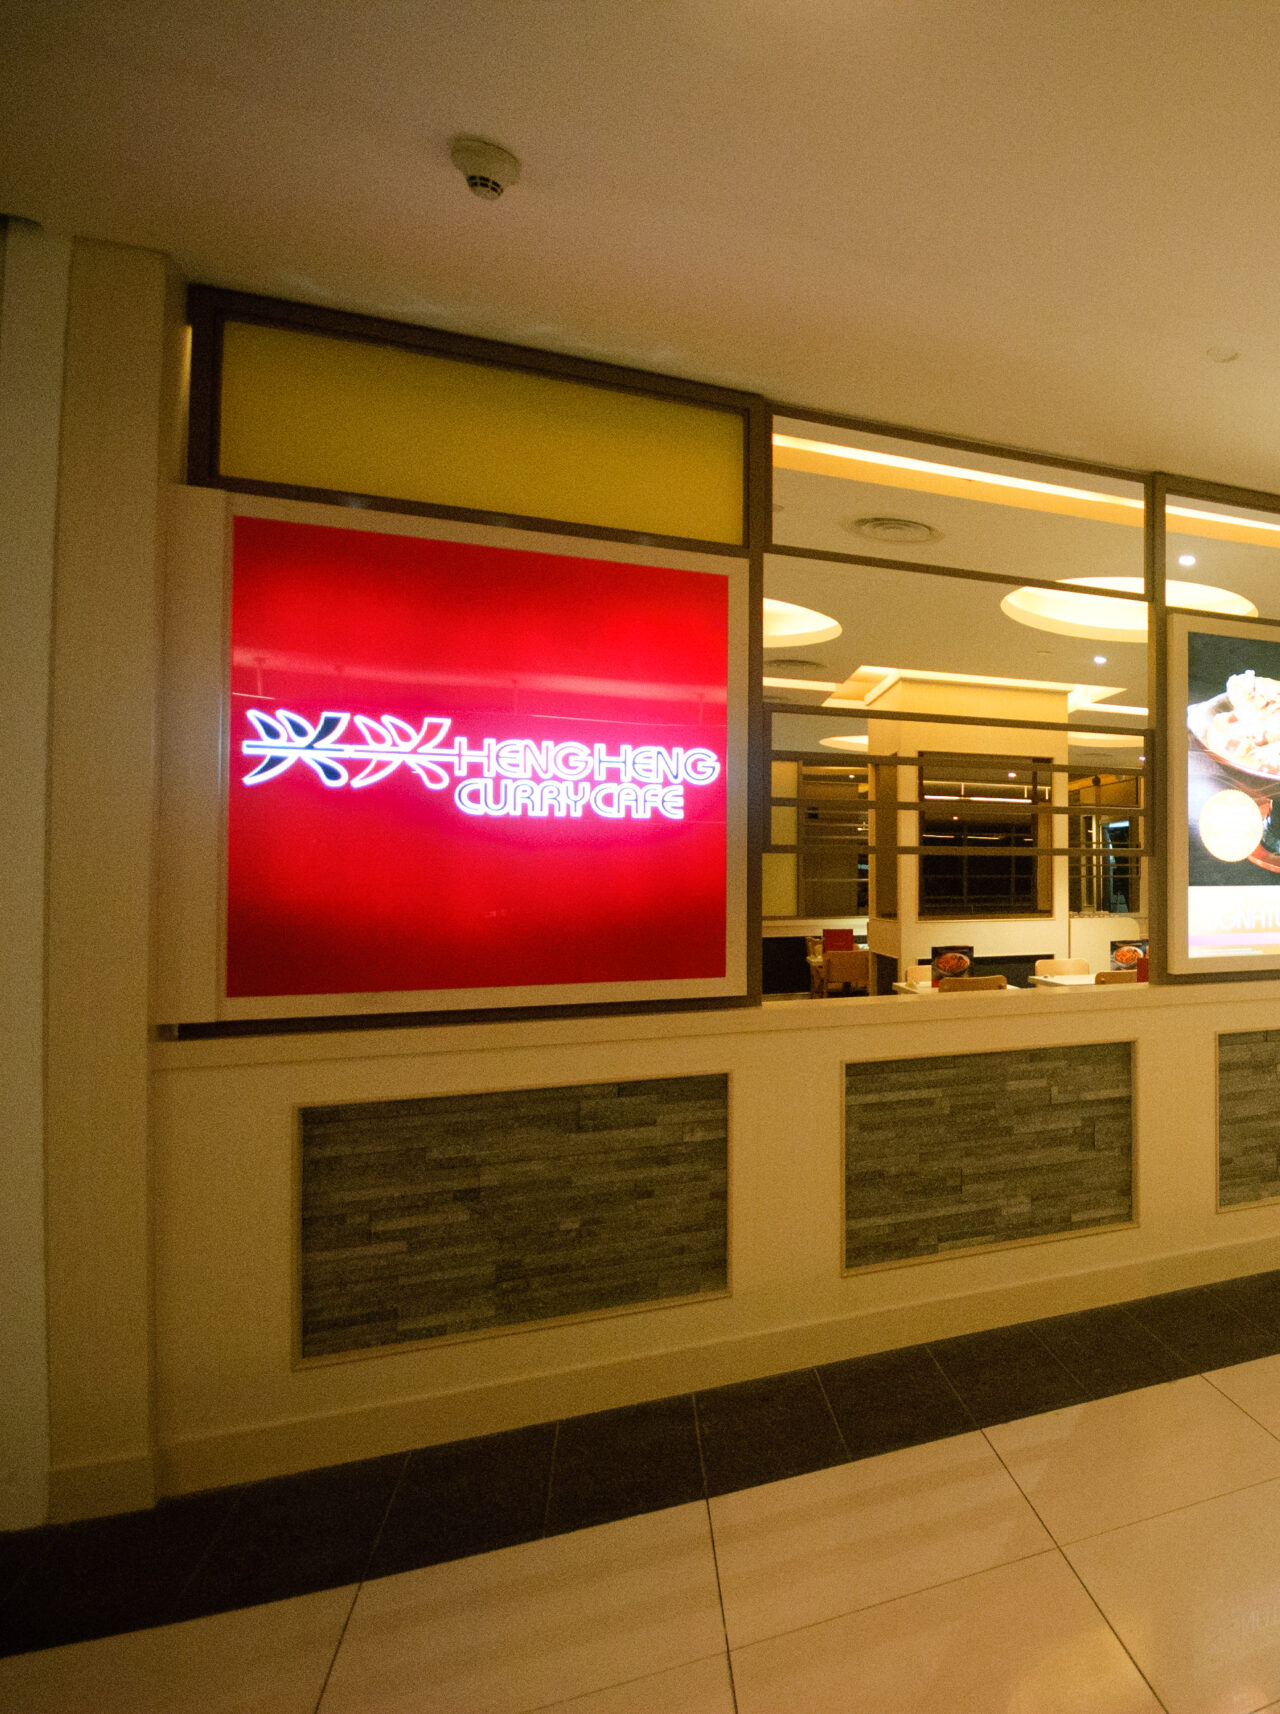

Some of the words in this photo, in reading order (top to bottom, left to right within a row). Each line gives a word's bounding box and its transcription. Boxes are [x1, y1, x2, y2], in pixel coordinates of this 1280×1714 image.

[454, 735, 594, 782] HENG
[593, 743, 721, 786] HENG
[453, 778, 593, 818] CURRY
[590, 783, 685, 820] CAFE
